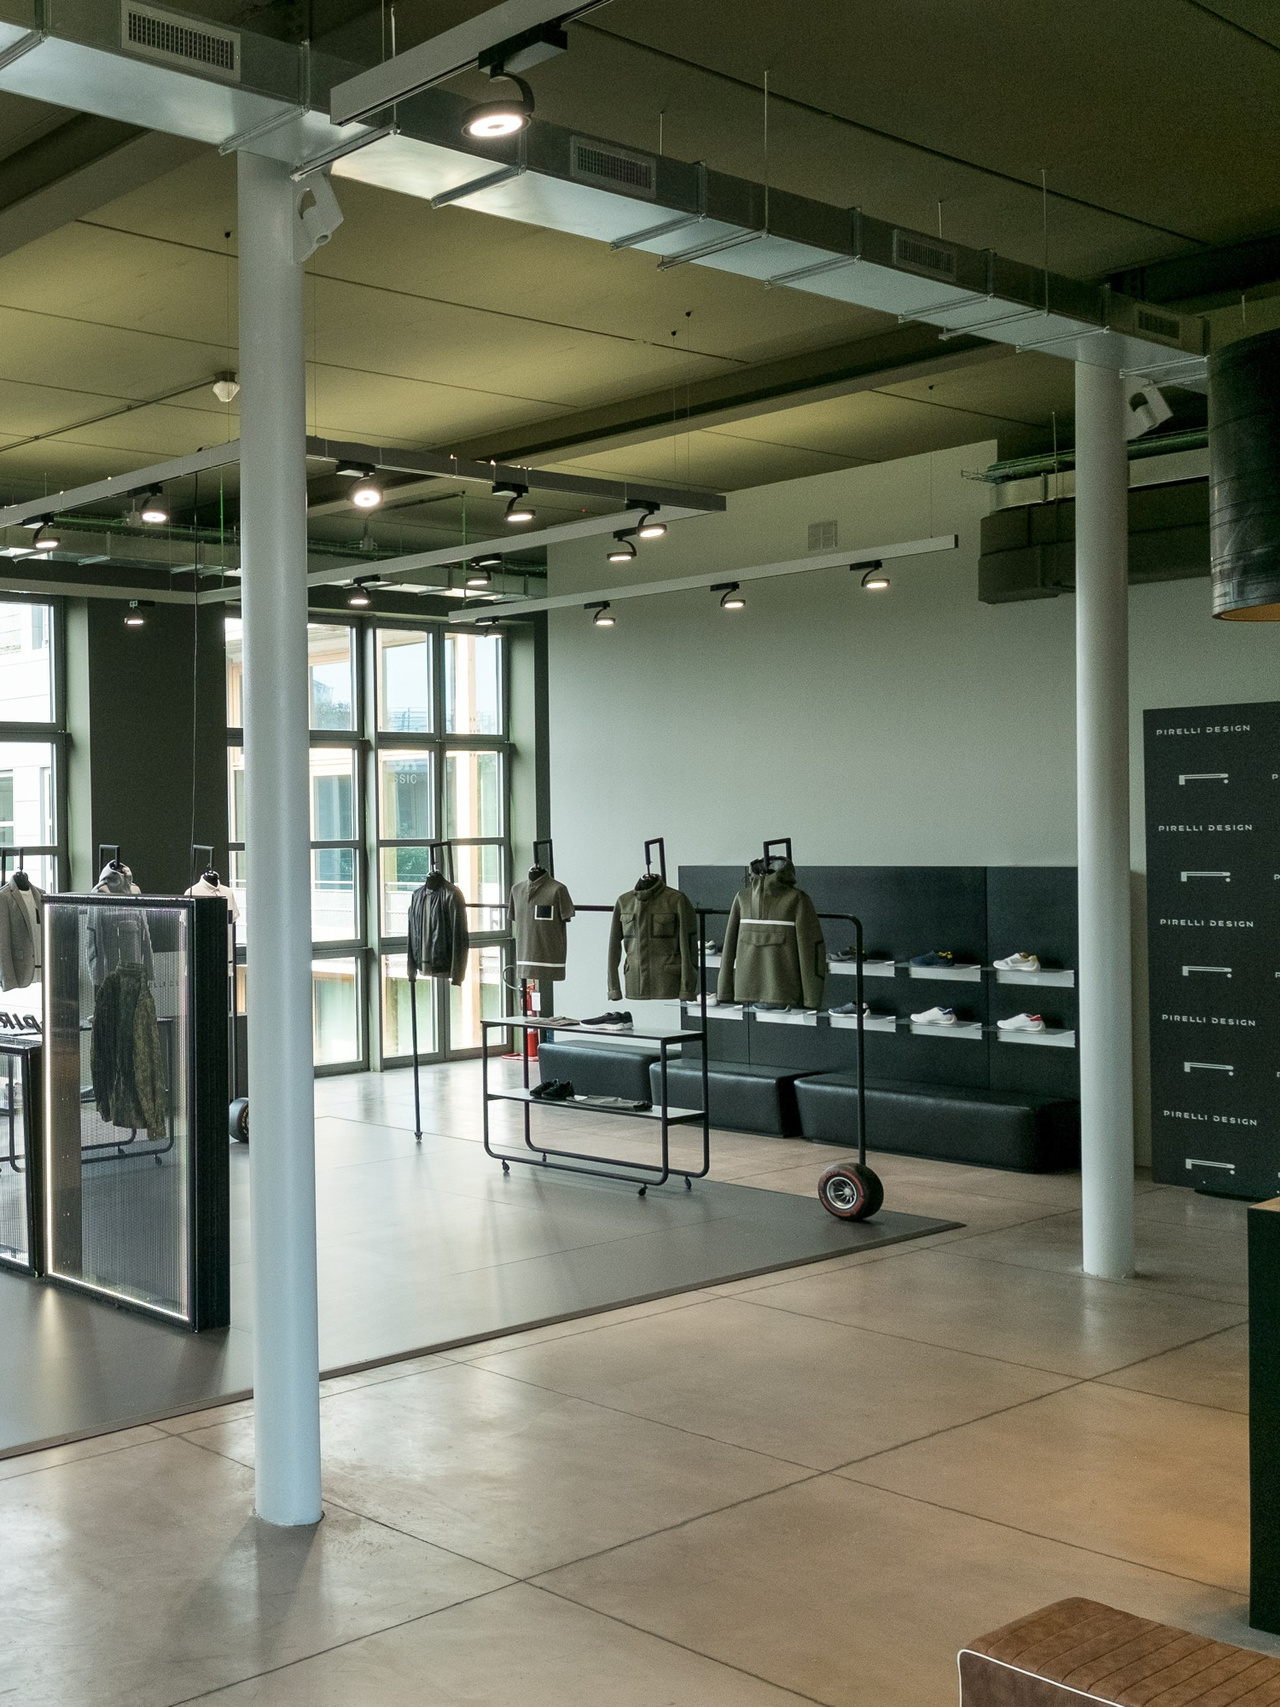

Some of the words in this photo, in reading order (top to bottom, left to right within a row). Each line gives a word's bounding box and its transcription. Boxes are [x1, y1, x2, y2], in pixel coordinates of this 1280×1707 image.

[1156, 727, 1201, 736] PIRELLI
[1206, 724, 1251, 733] DESIGN
[1160, 918, 1205, 926] PIRELLI
[1209, 920, 1254, 928] DESIGN
[1162, 1014, 1206, 1023] PIRELLI
[1211, 1017, 1256, 1027] DESIGN
[1163, 1110, 1208, 1121] PIRELLI
[1213, 1115, 1258, 1126] DESIGN
